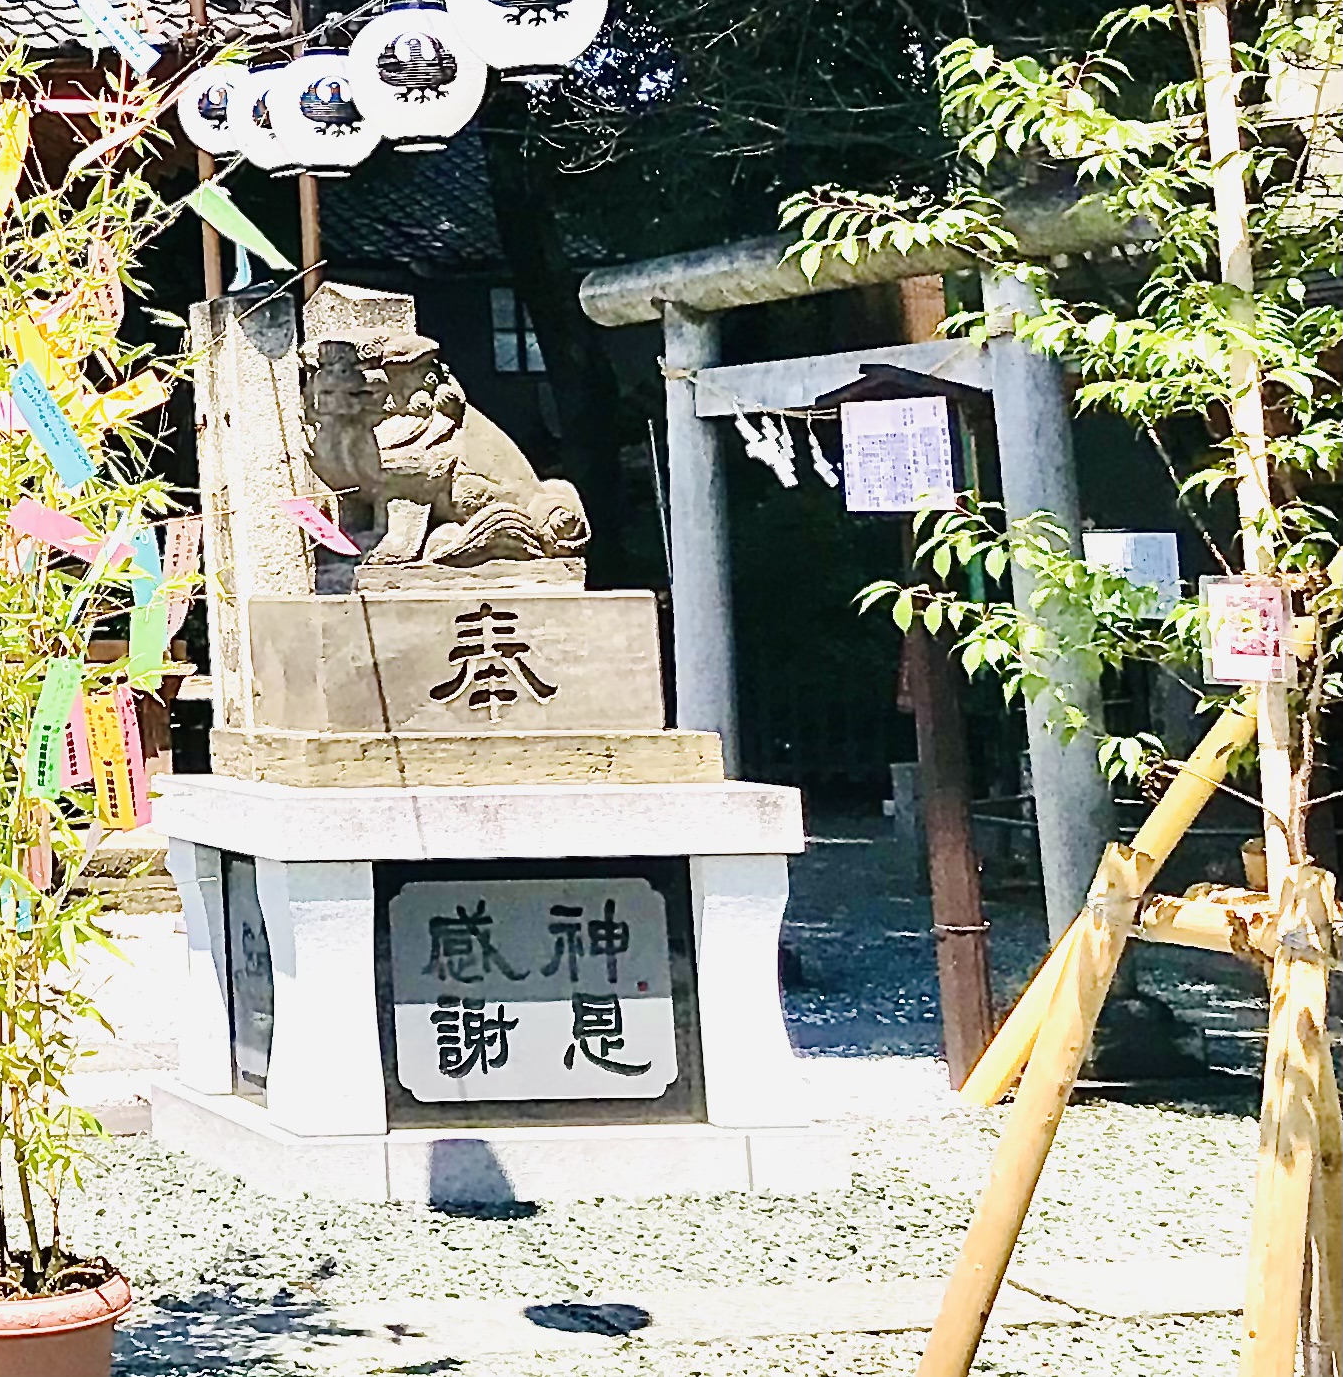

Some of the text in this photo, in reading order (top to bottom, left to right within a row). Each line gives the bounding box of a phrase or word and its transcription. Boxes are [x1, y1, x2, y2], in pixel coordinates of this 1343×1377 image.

[429, 602, 560, 722] 奉
[421, 899, 531, 1078] 感謝
[540, 898, 652, 1076] 神恩
